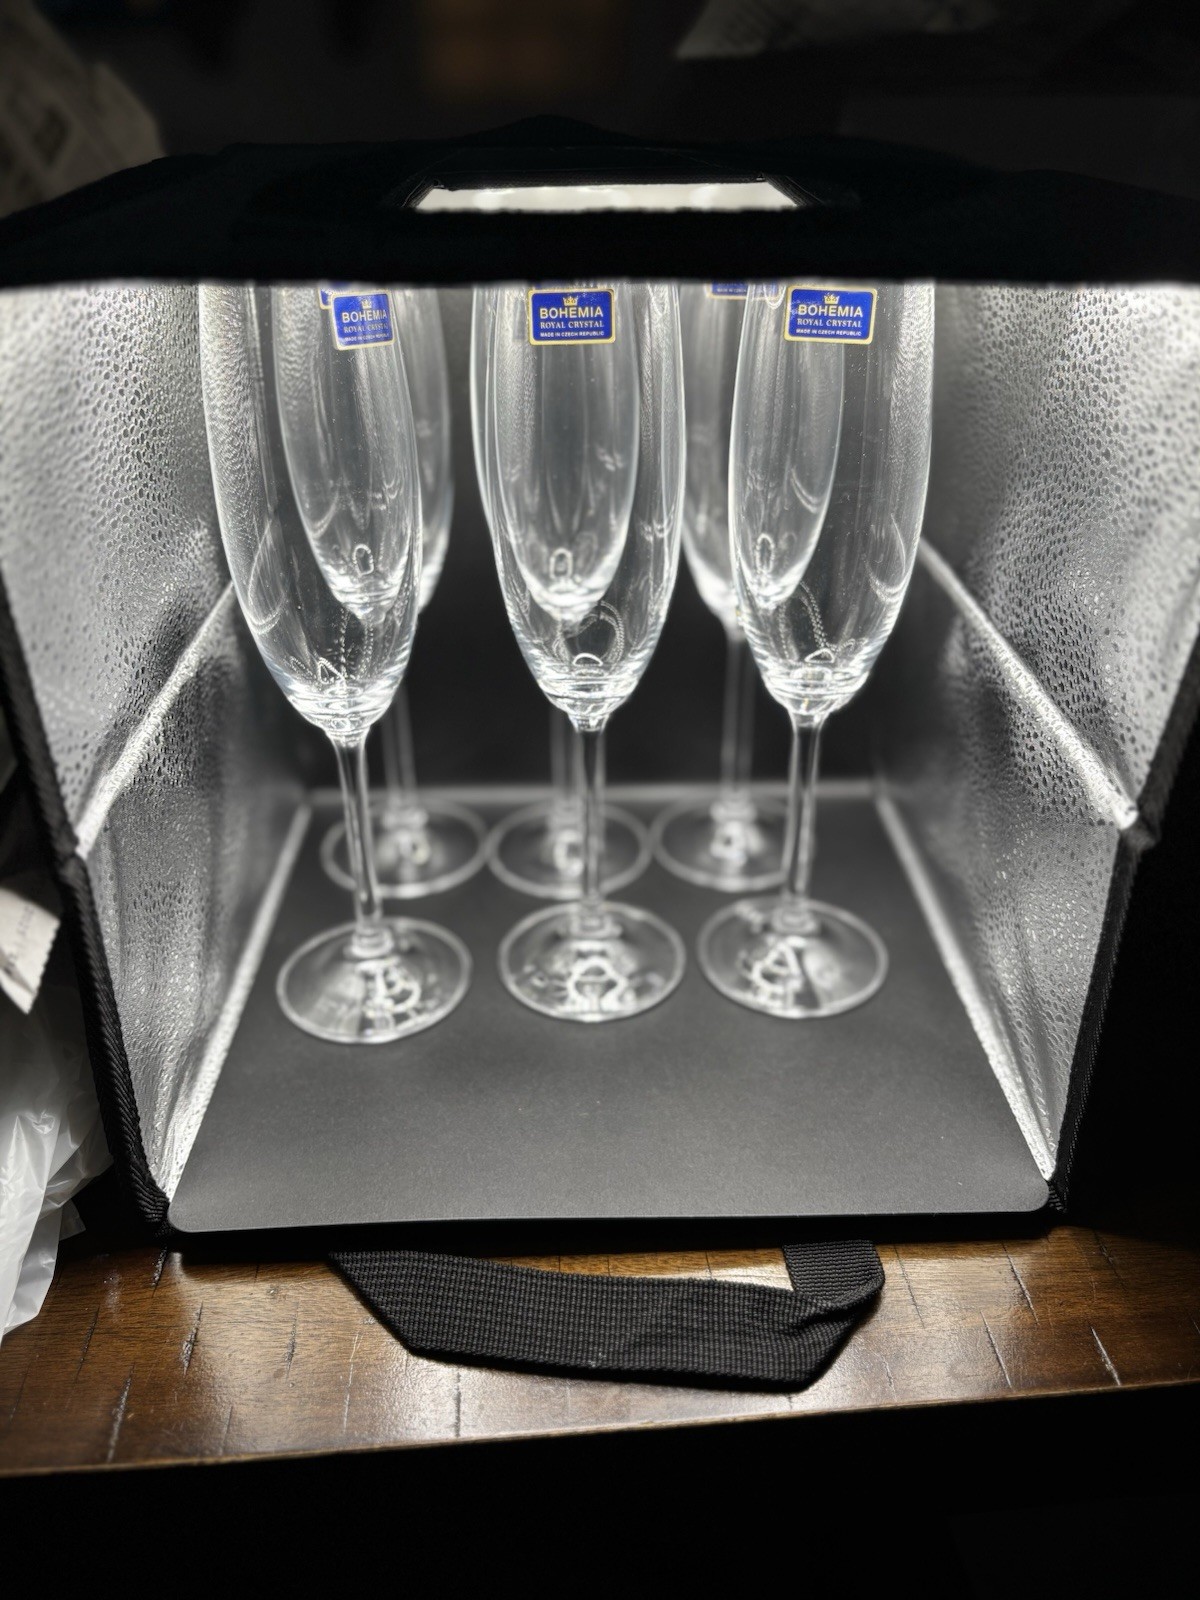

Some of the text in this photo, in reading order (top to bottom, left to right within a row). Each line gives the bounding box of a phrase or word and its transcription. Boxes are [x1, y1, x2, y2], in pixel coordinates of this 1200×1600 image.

[341, 309, 388, 323] BOHEMIA
[539, 306, 604, 319] BOHEMIA
[797, 304, 864, 318] BOHEMIA
[540, 320, 605, 330] ROYAL CRYSTAL
[797, 318, 863, 328] ROYAL CRYSTAL
[343, 325, 366, 334] ROYAL
